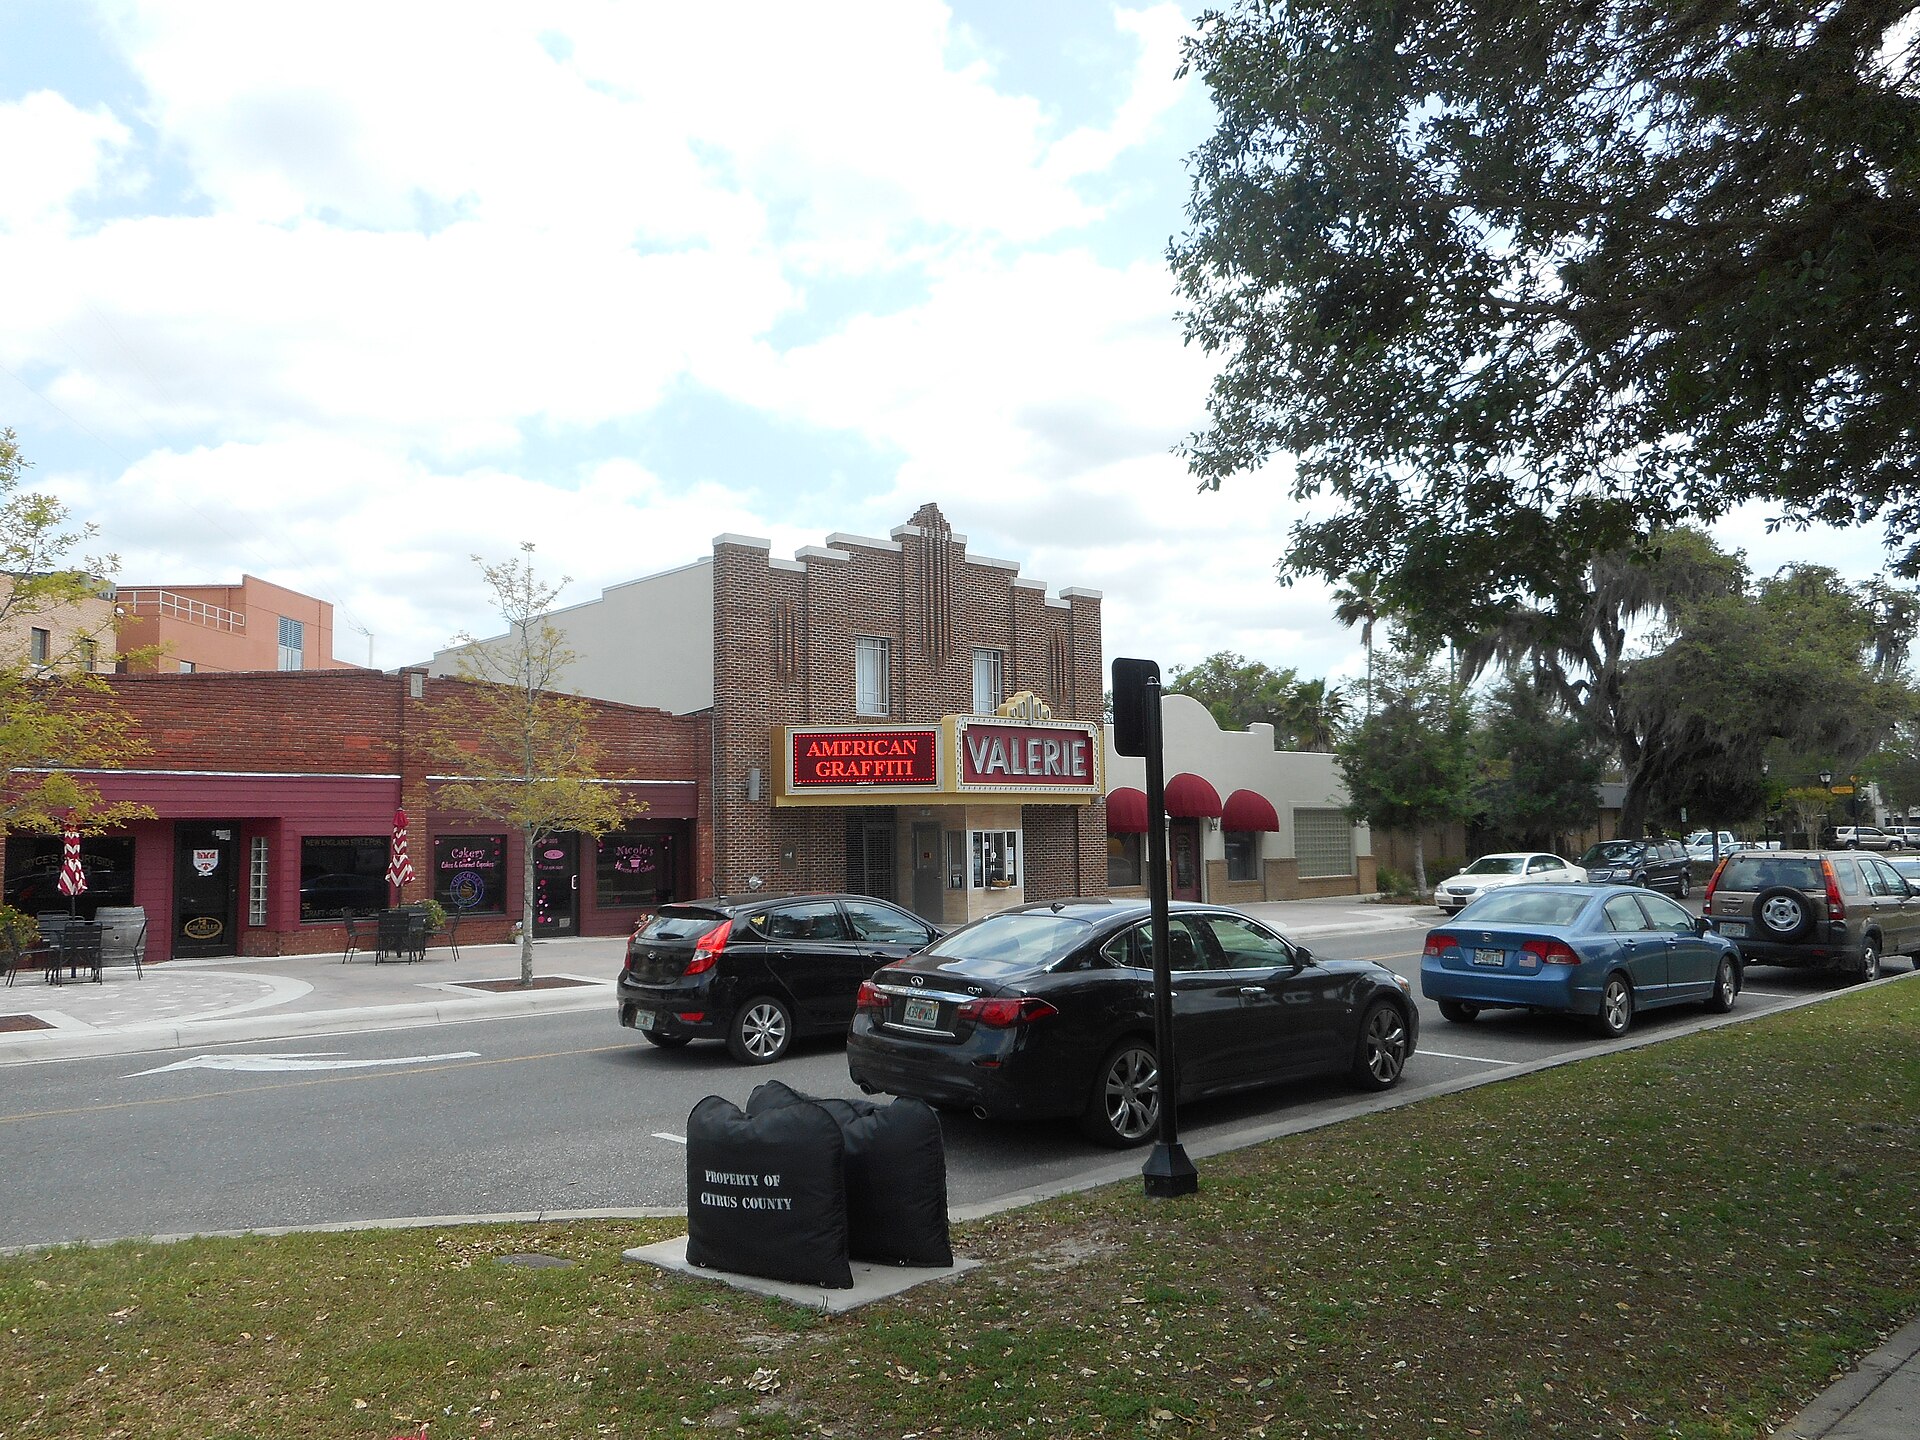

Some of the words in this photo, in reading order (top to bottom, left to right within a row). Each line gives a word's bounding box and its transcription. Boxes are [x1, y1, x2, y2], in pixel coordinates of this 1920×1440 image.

[806, 739, 917, 757] AMERICAN
[967, 735, 1088, 777] VALERIE
[815, 760, 914, 777] GRAFFITI
[451, 846, 486, 860] Cakery
[616, 844, 654, 856] Nicole's
[967, 986, 983, 995] Q70
[705, 1169, 759, 1187] PROPERTY
[763, 1174, 781, 1187] OF
[700, 1191, 738, 1209] CITRUS
[742, 1197, 792, 1210] COUNTY
